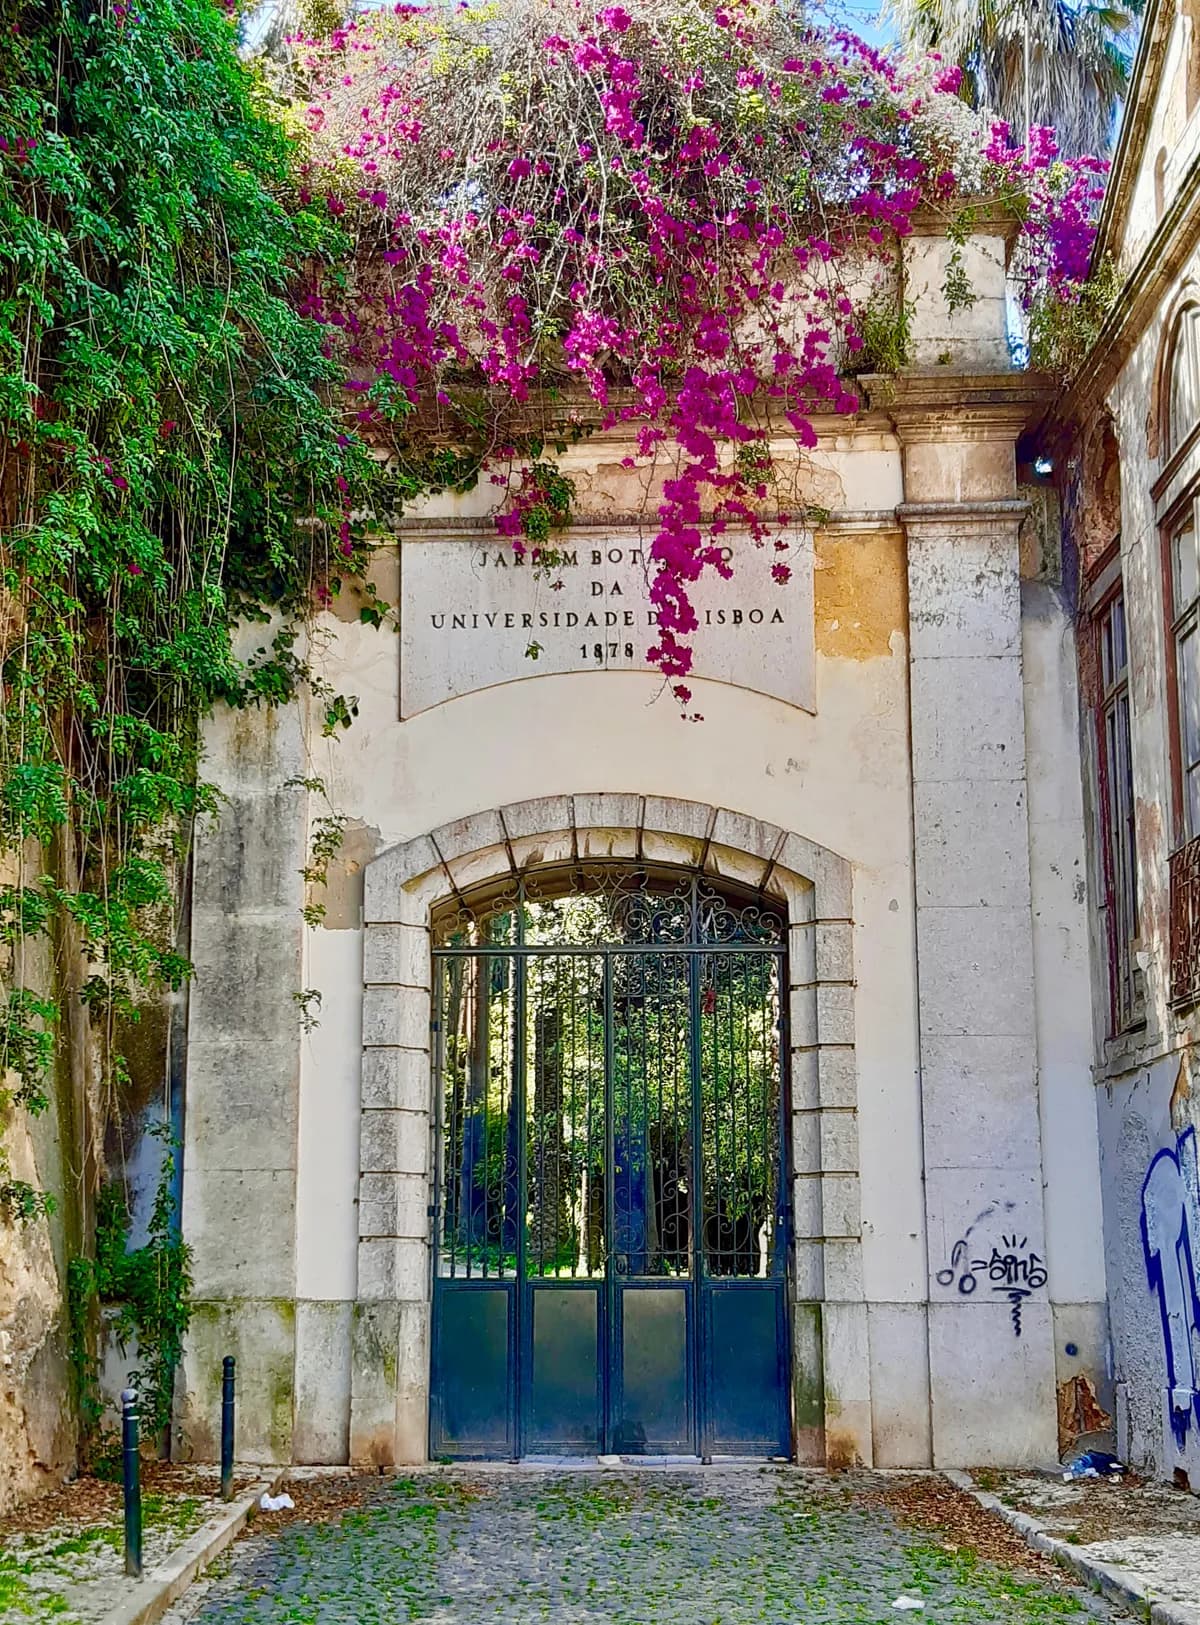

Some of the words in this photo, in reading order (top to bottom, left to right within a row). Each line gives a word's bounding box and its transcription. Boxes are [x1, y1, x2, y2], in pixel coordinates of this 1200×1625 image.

[591, 581, 623, 596] DA
[431, 612, 635, 630] UNIVERSIDADE
[648, 611, 670, 627] D
[698, 608, 785, 625] ISBOA
[580, 642, 634, 659] 1878
